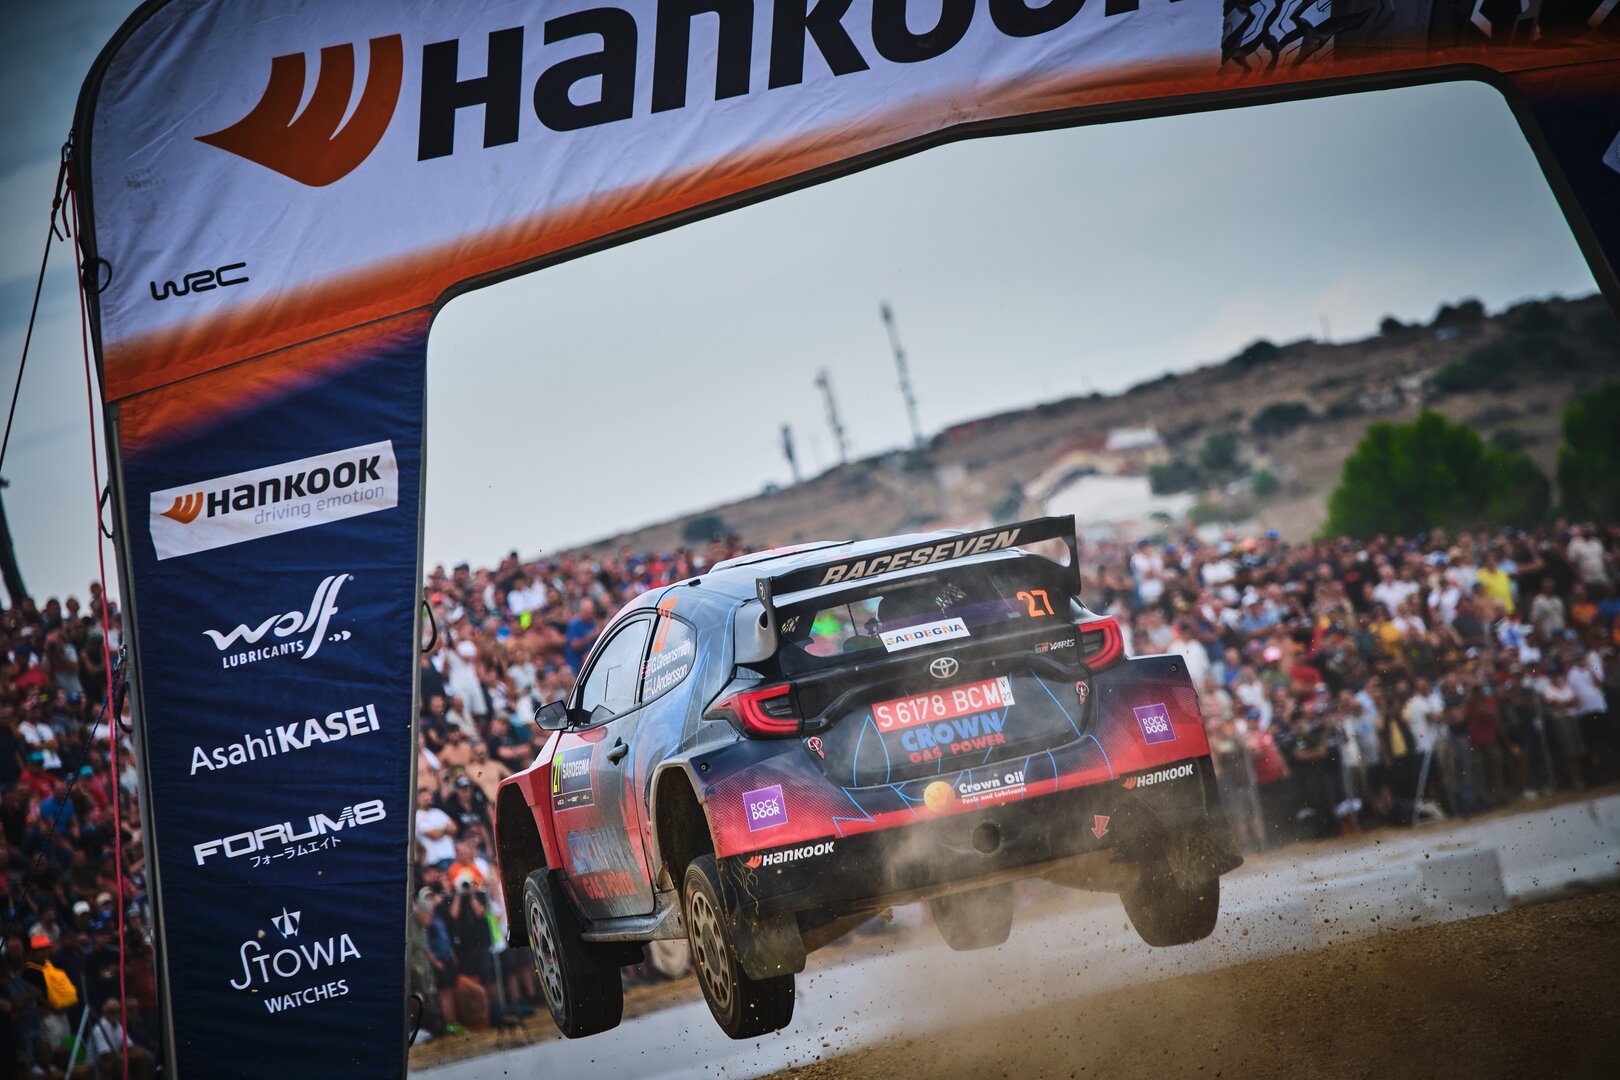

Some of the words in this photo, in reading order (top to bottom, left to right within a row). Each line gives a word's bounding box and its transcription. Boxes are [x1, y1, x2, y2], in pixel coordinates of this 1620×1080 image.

[150, 261, 249, 301] WRC
[254, 500, 311, 525] driving
[316, 486, 384, 511] emotion
[819, 528, 1021, 586] RACESEVEN
[1016, 589, 1055, 618] 27
[885, 622, 964, 646] SARDEGNA
[222, 640, 304, 669] LUBRICANTS
[877, 706, 893, 728] S
[895, 695, 946, 725] 6178
[951, 682, 1001, 712] BCM
[1142, 715, 1165, 726] ROCK
[190, 704, 380, 776] AsahiKASEI
[901, 711, 1003, 751] CROWN
[1145, 723, 1169, 734] DOOR
[909, 747, 943, 764] GAS
[951, 733, 1006, 755] POWER
[959, 779, 1001, 794] Crown
[1004, 771, 1025, 784] Oil
[750, 798, 779, 812] ROCK
[752, 806, 780, 820] DOOR
[193, 799, 386, 866] FORUM8
[250, 835, 341, 867] フォーラムエイト
[264, 979, 349, 1013] WATCHES
